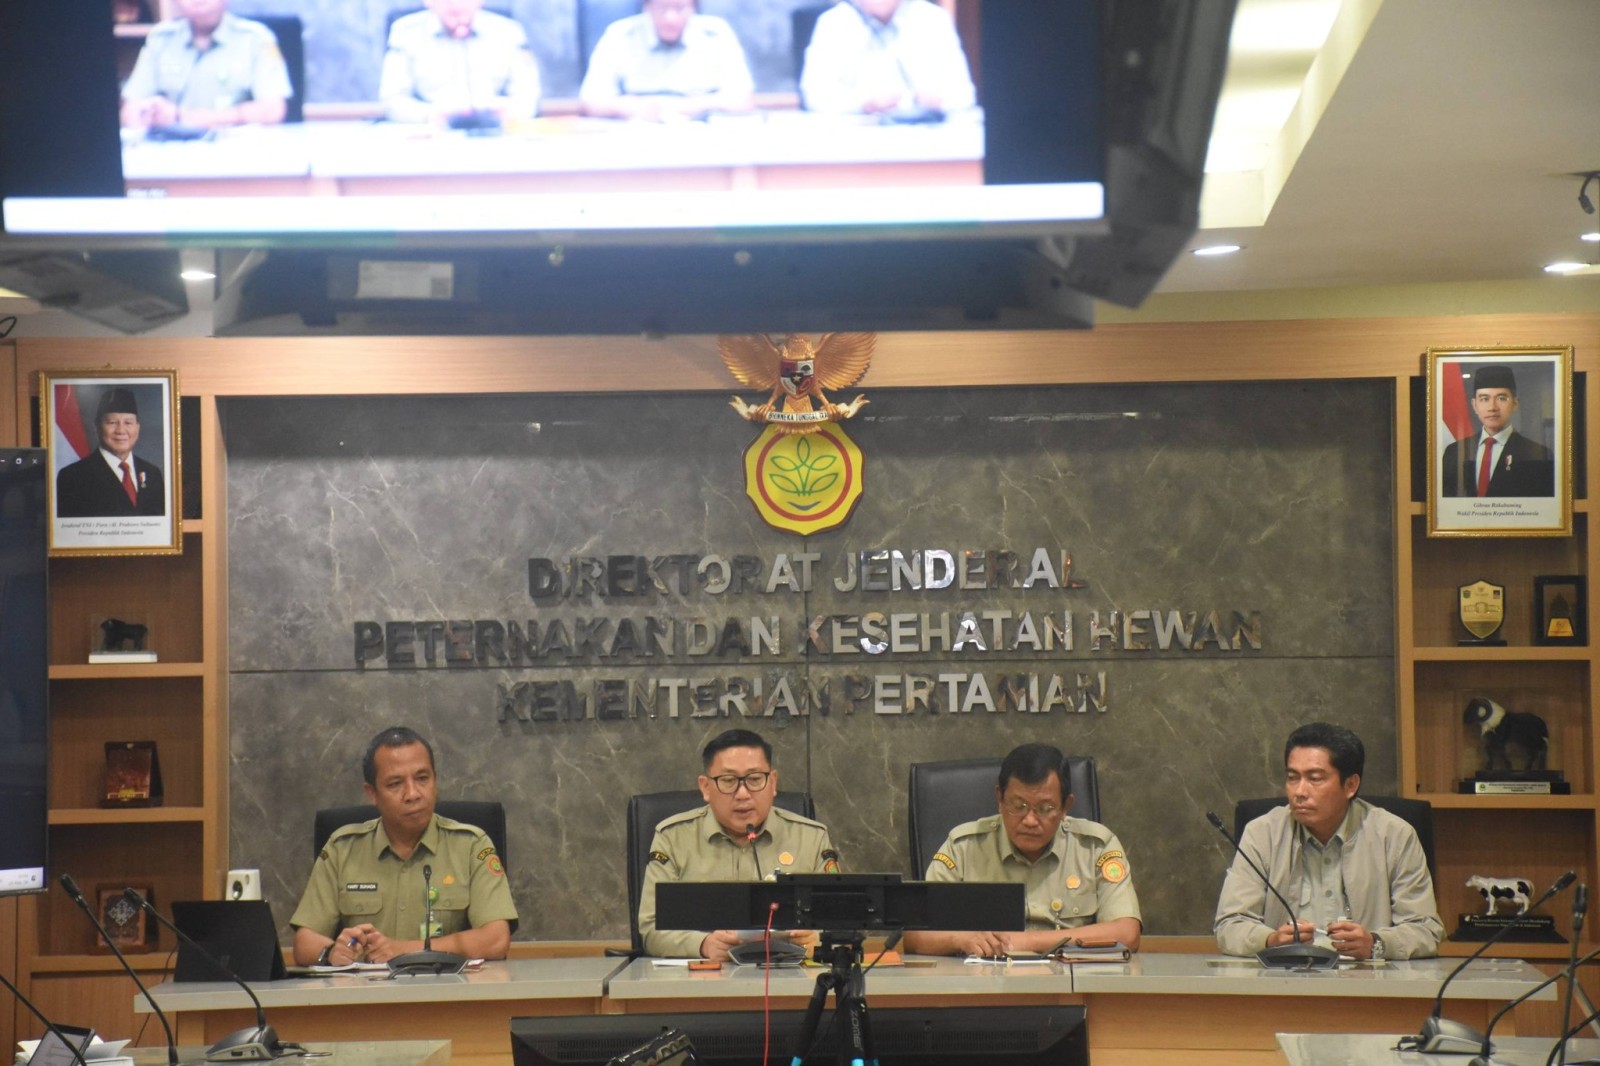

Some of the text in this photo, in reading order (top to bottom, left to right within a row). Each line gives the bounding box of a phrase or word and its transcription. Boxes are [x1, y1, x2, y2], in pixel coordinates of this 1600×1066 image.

[528, 547, 1086, 598] DIREKTORAT JENDERAL
[354, 609, 1262, 663] PETERNAKAN DAN KESEHATAN HEWAN
[499, 672, 1108, 722] KEMENTERIAN PERTANIAN
